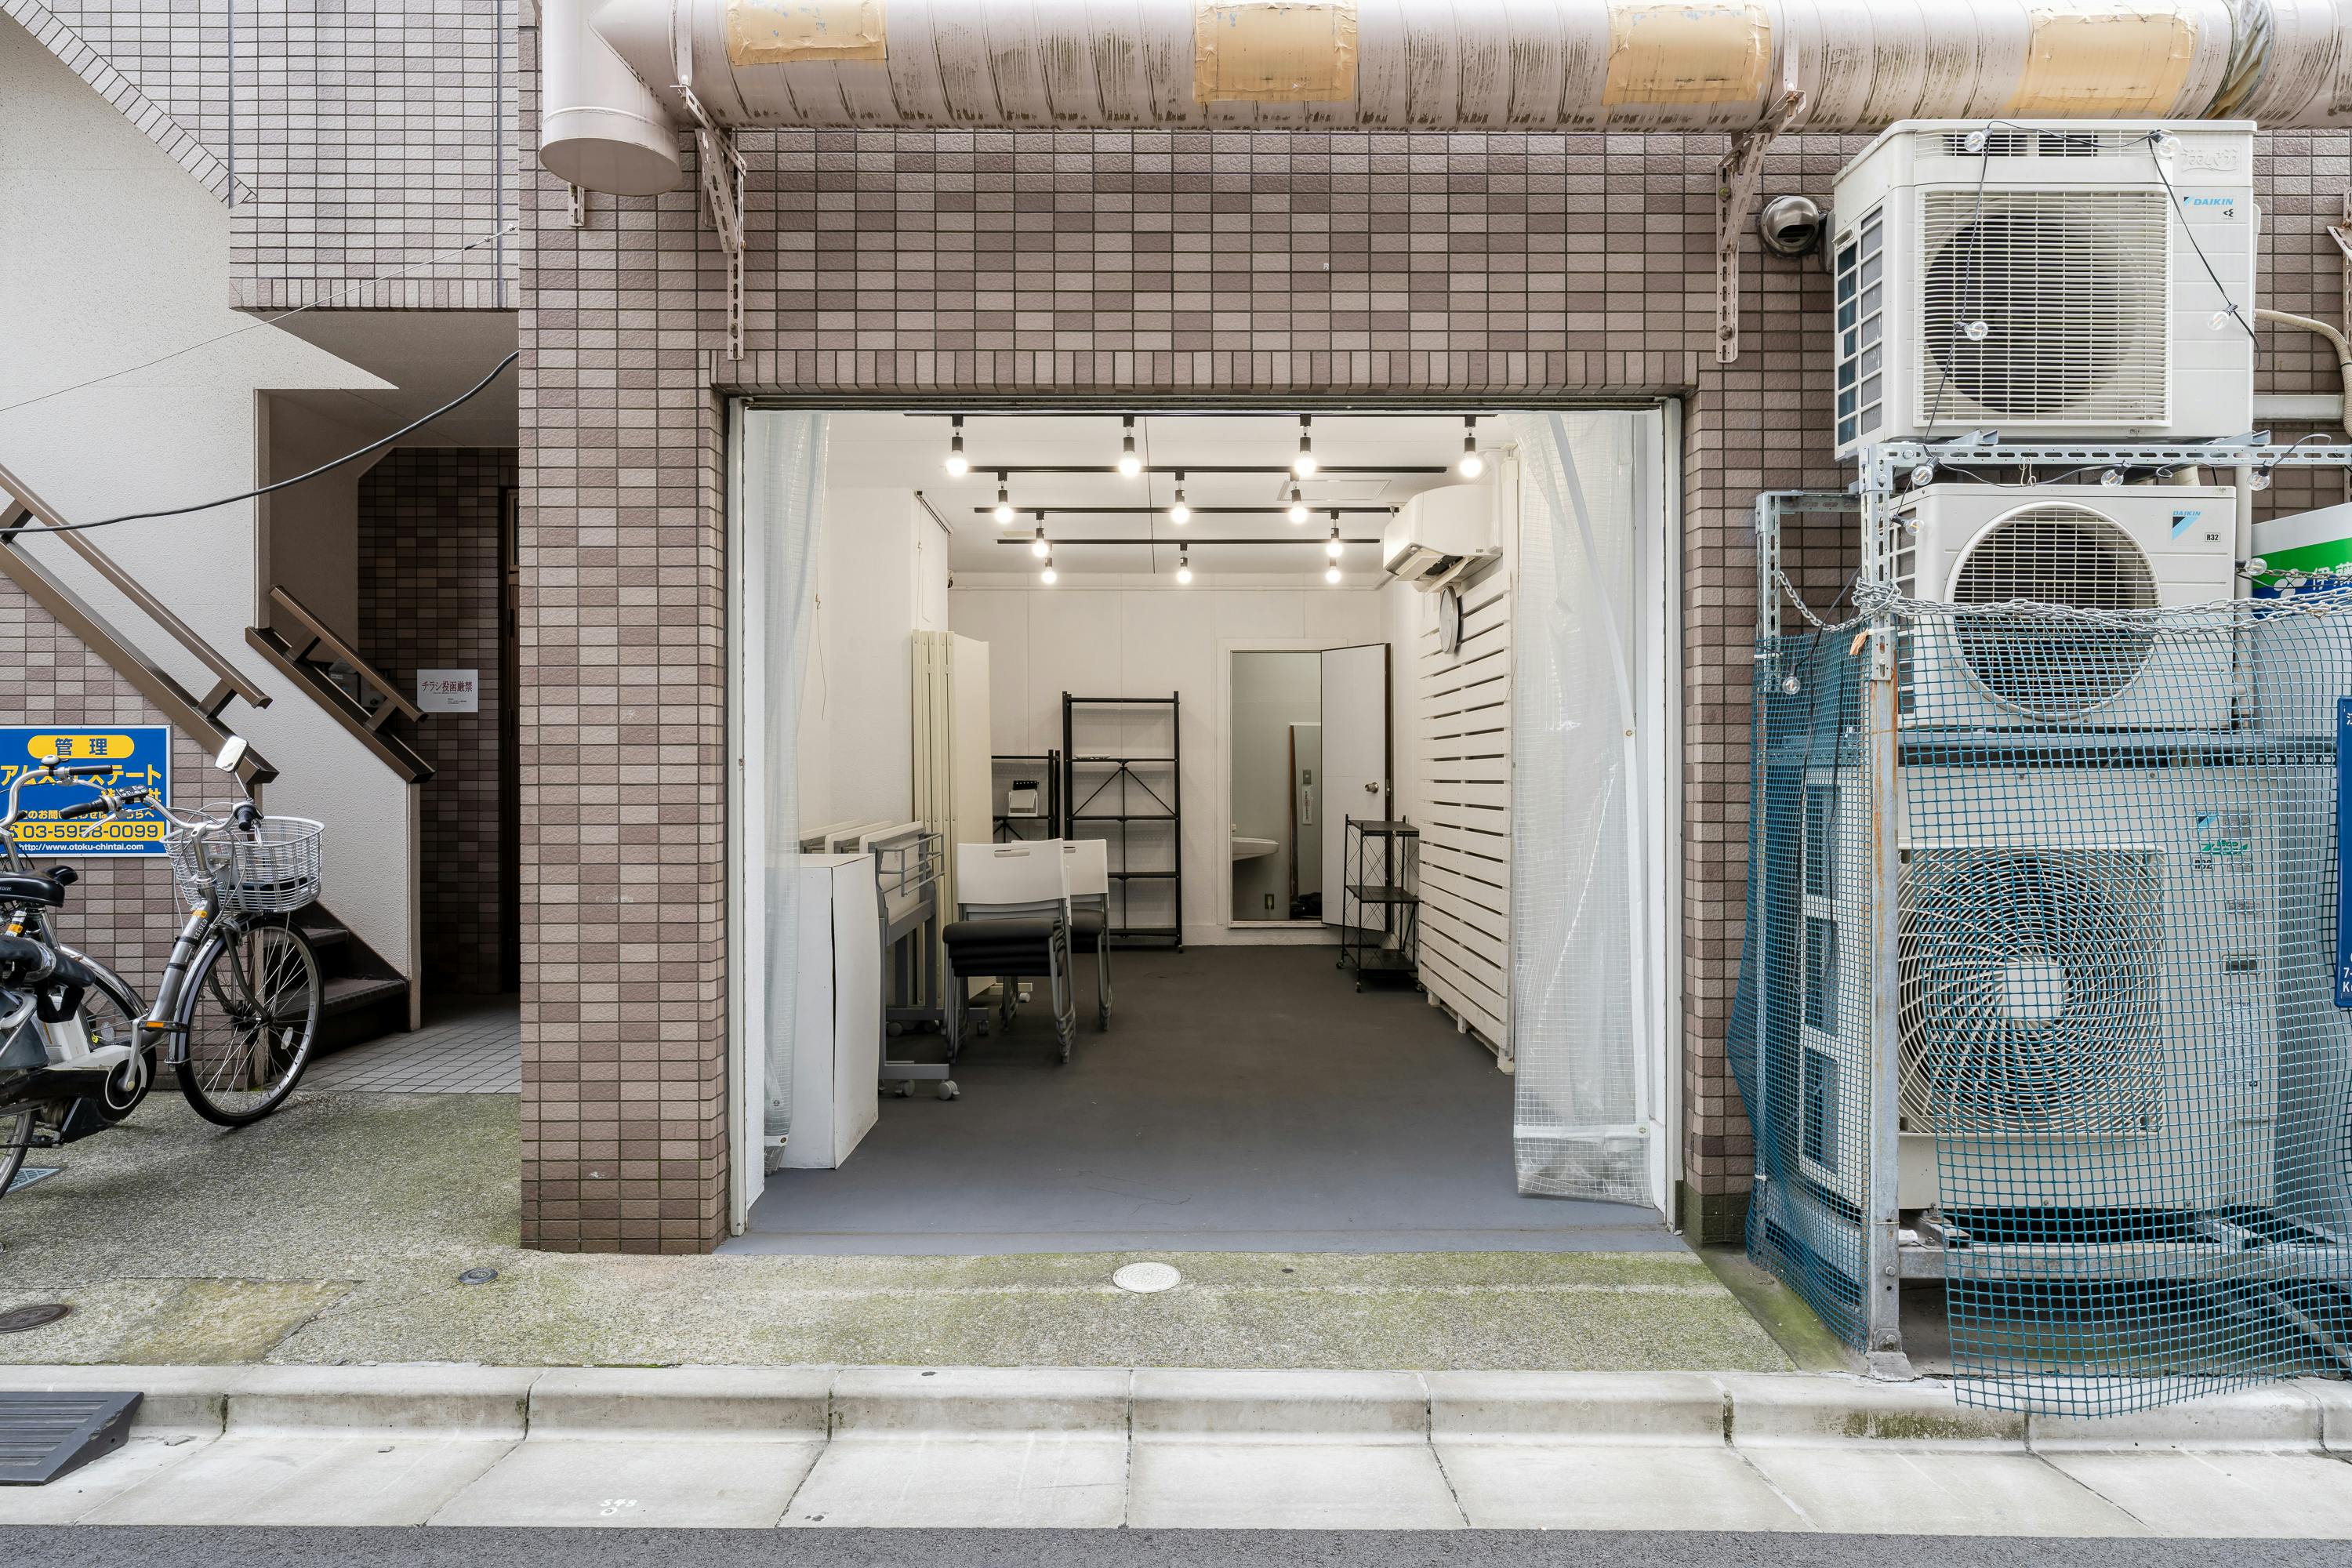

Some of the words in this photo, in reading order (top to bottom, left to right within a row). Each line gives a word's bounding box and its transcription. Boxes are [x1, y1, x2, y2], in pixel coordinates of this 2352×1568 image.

[422, 681, 473, 692] チラシ投函厳禁
[55, 738, 108, 756] 管理
[23, 825, 158, 839] 03-5958-0099
[19, 843, 143, 851] http://www.otoku-chintai.com
